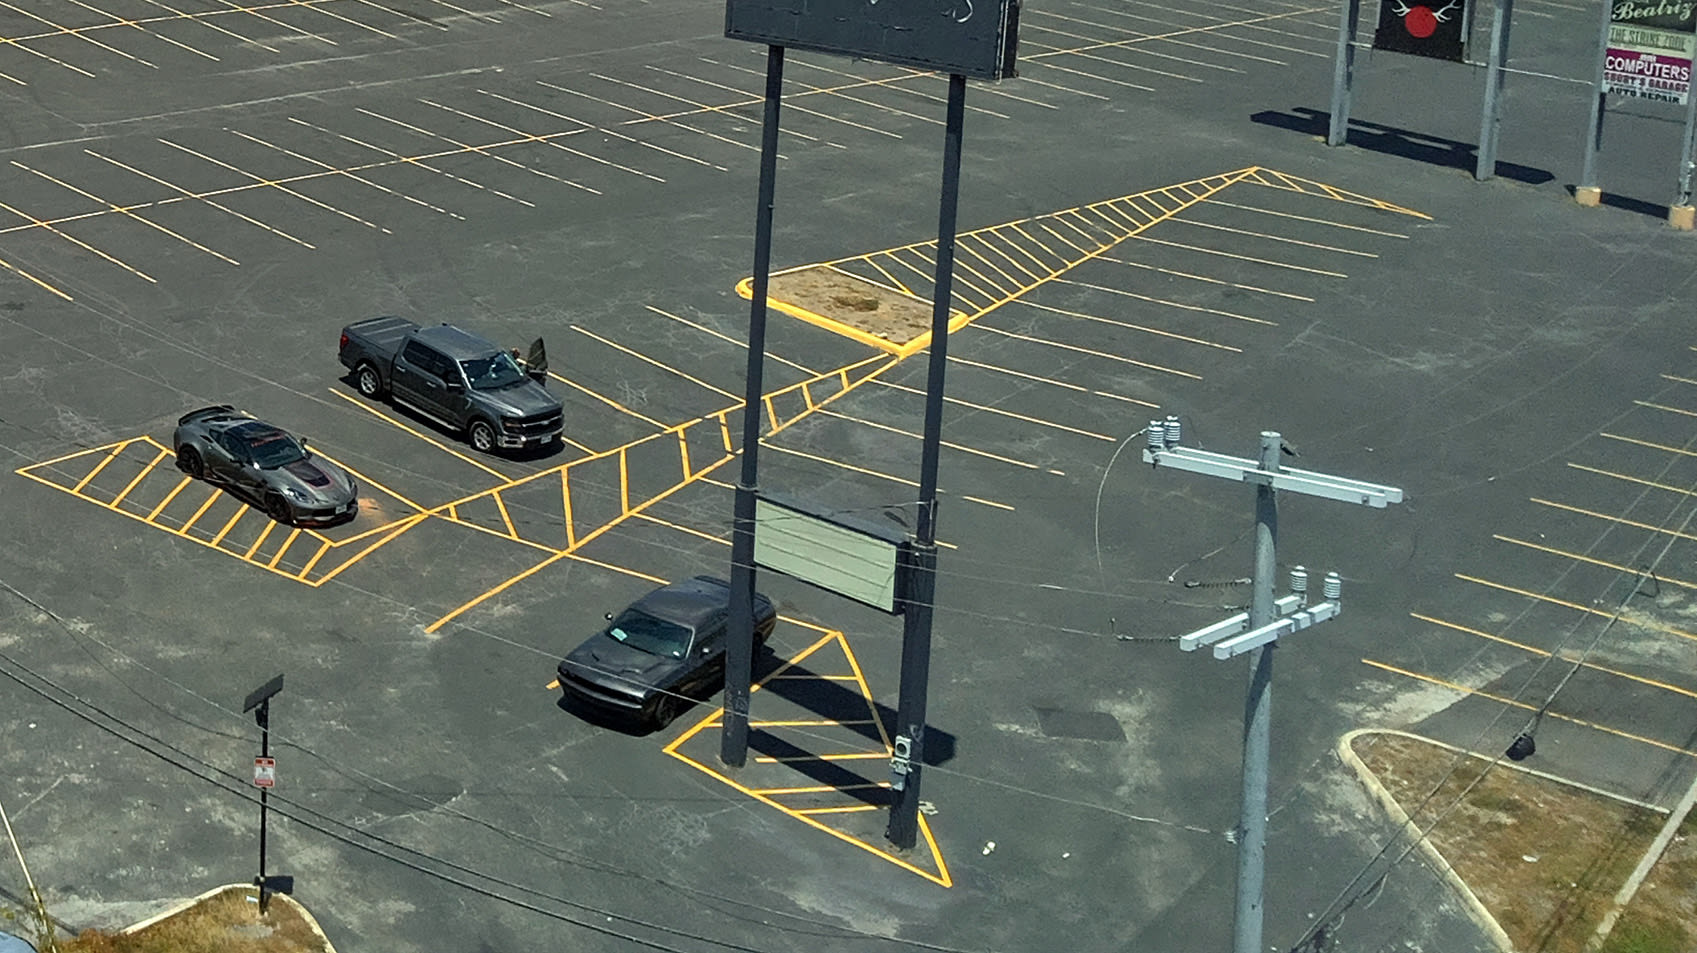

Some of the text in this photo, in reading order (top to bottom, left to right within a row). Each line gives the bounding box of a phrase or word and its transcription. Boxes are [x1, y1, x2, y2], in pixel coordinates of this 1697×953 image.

[1610, 28, 1625, 43] THE
[1606, 56, 1689, 81] COMPUTERS
[1608, 86, 1636, 97] AUTO
[1640, 92, 1680, 104] REPAIR
